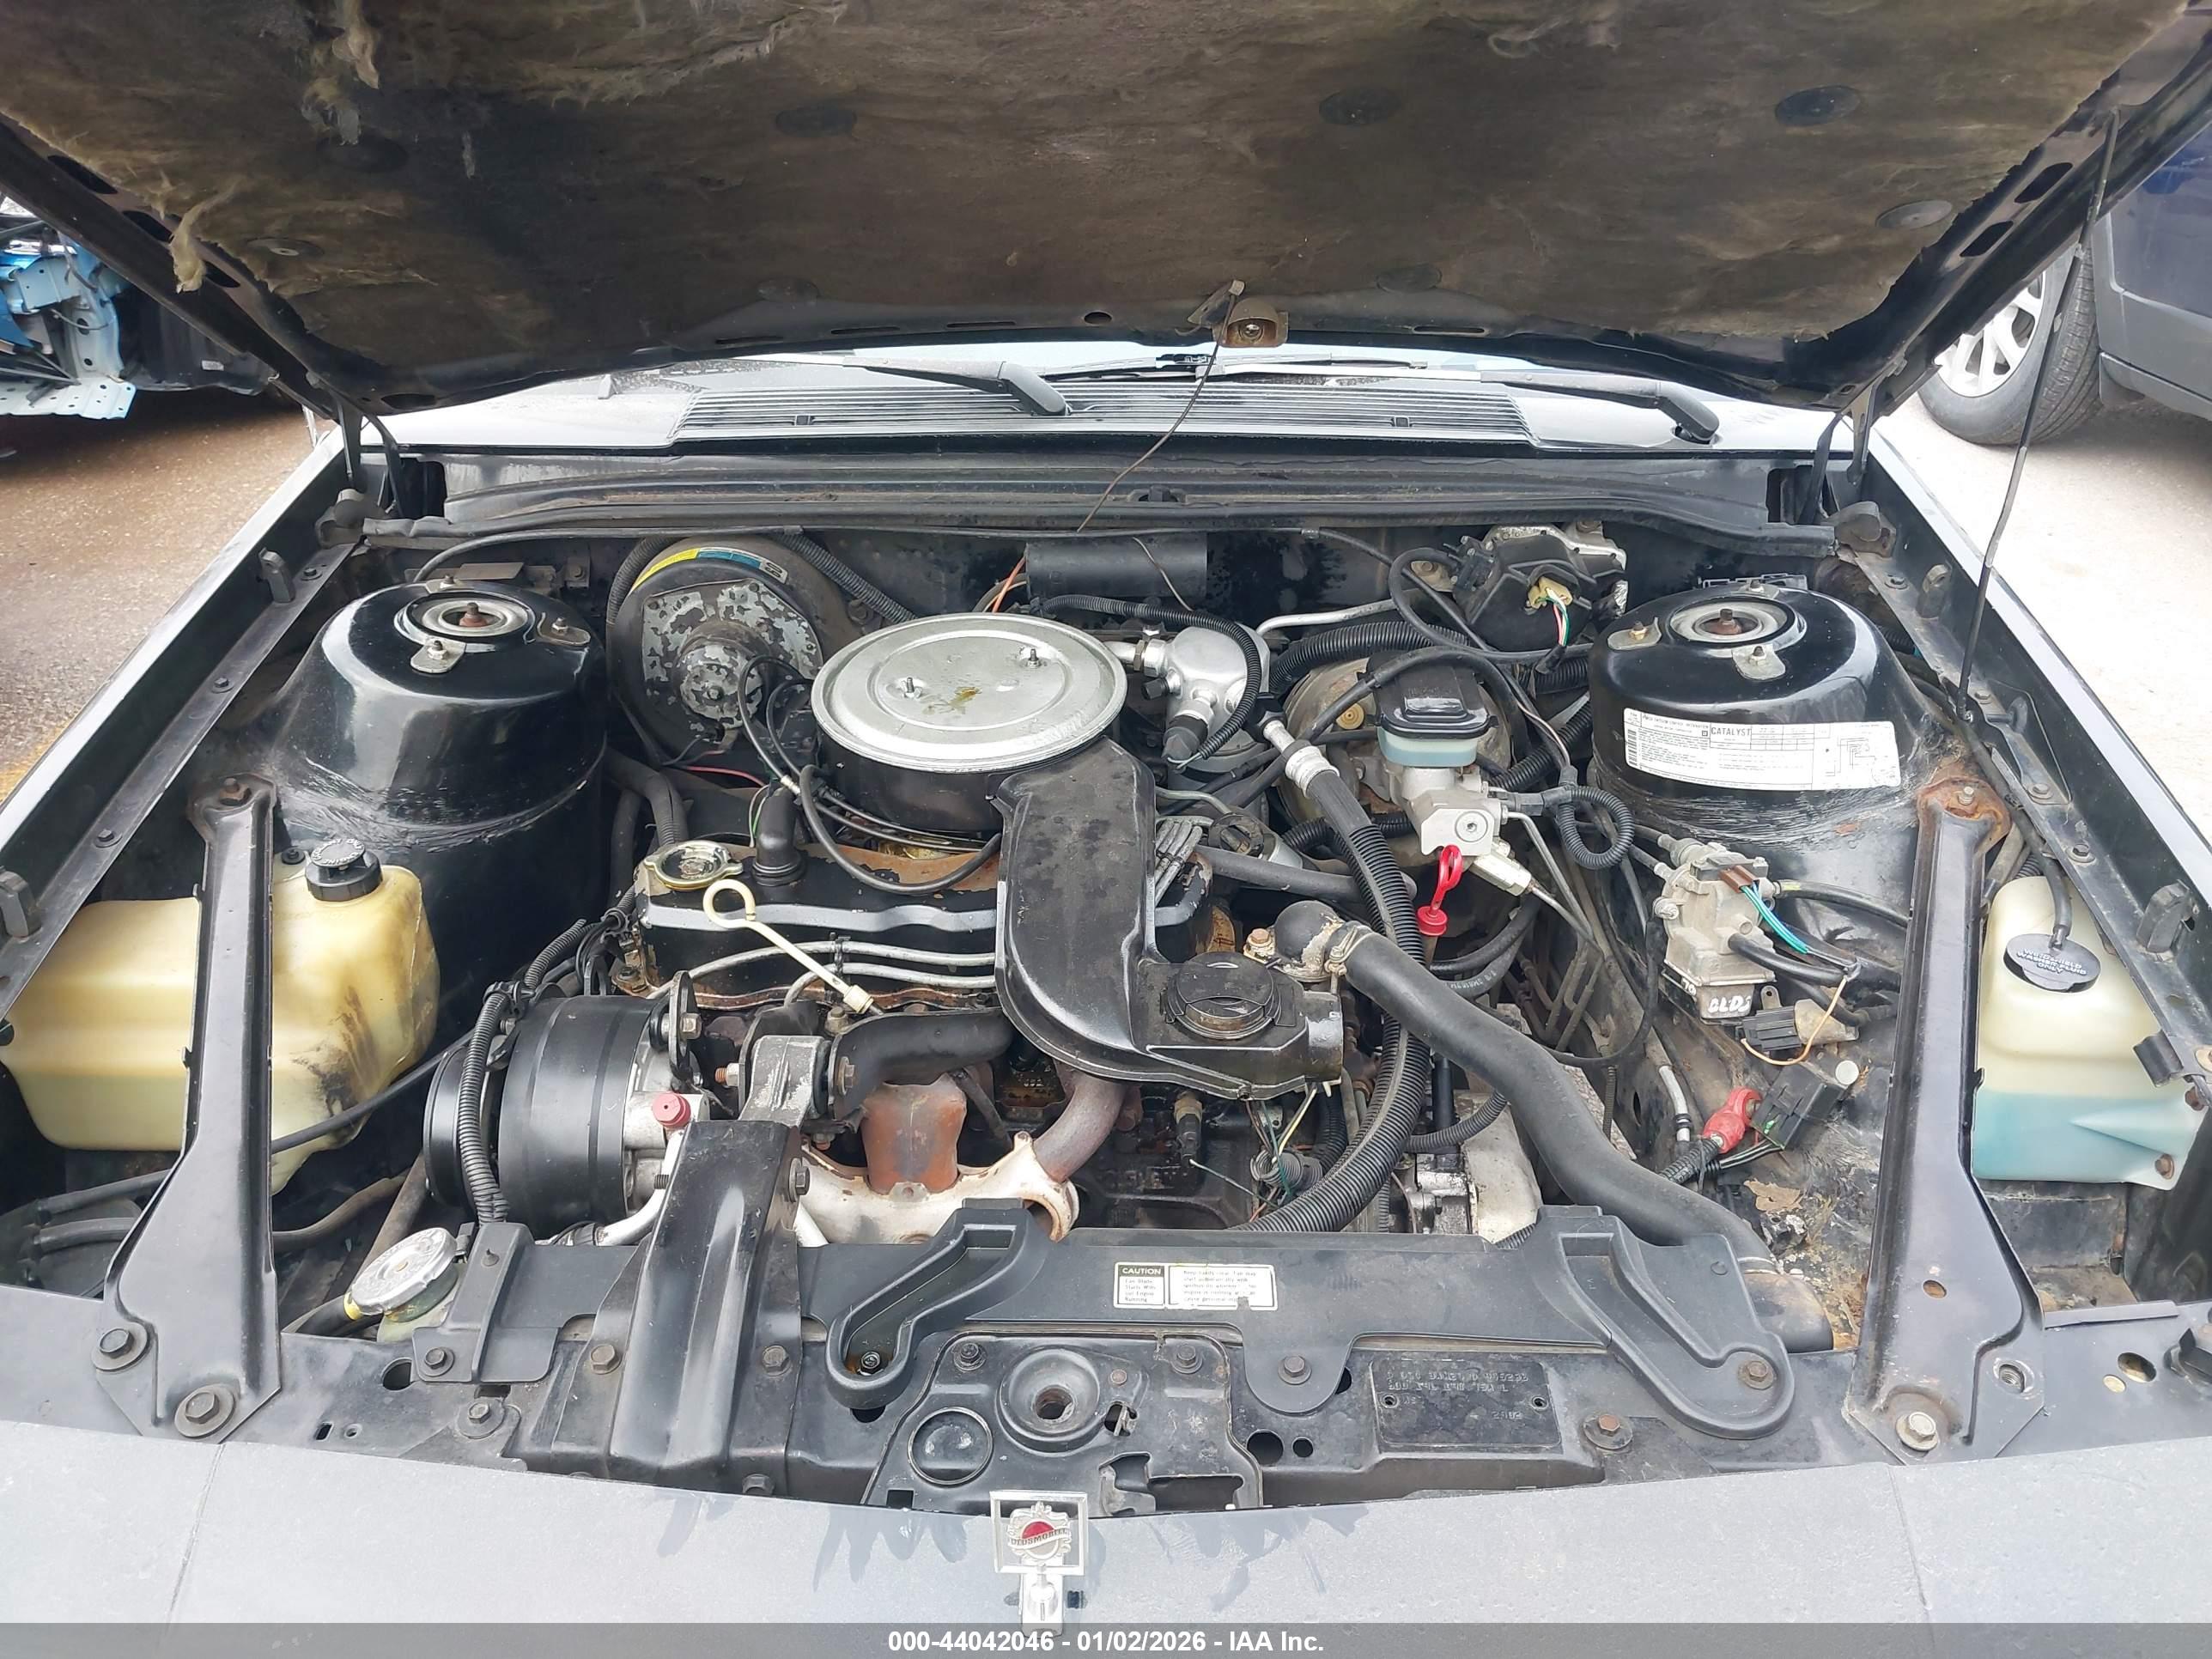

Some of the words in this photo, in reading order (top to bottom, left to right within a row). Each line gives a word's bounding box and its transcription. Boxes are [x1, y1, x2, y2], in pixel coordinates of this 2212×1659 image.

[1711, 726, 1751, 736] CATALYST
[2016, 951, 2057, 967] WASHER
[2058, 961, 2087, 975] FLUID
[2037, 962, 2063, 974] ONLY
